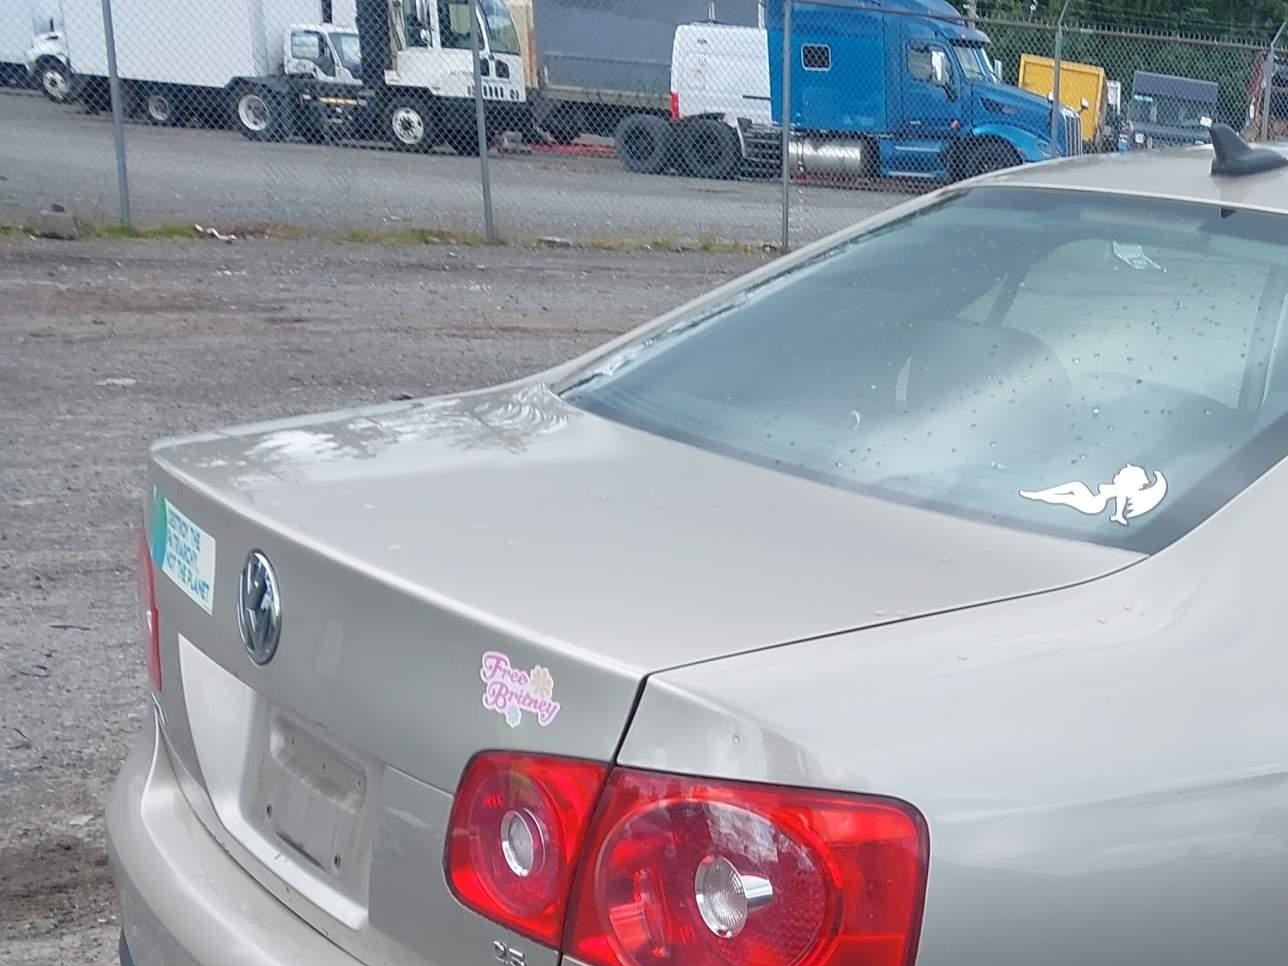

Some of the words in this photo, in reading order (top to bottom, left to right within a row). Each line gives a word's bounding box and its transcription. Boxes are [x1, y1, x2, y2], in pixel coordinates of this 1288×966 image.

[187, 566, 210, 602] PLANET
[483, 654, 529, 685] Free
[485, 681, 559, 723] Britney
